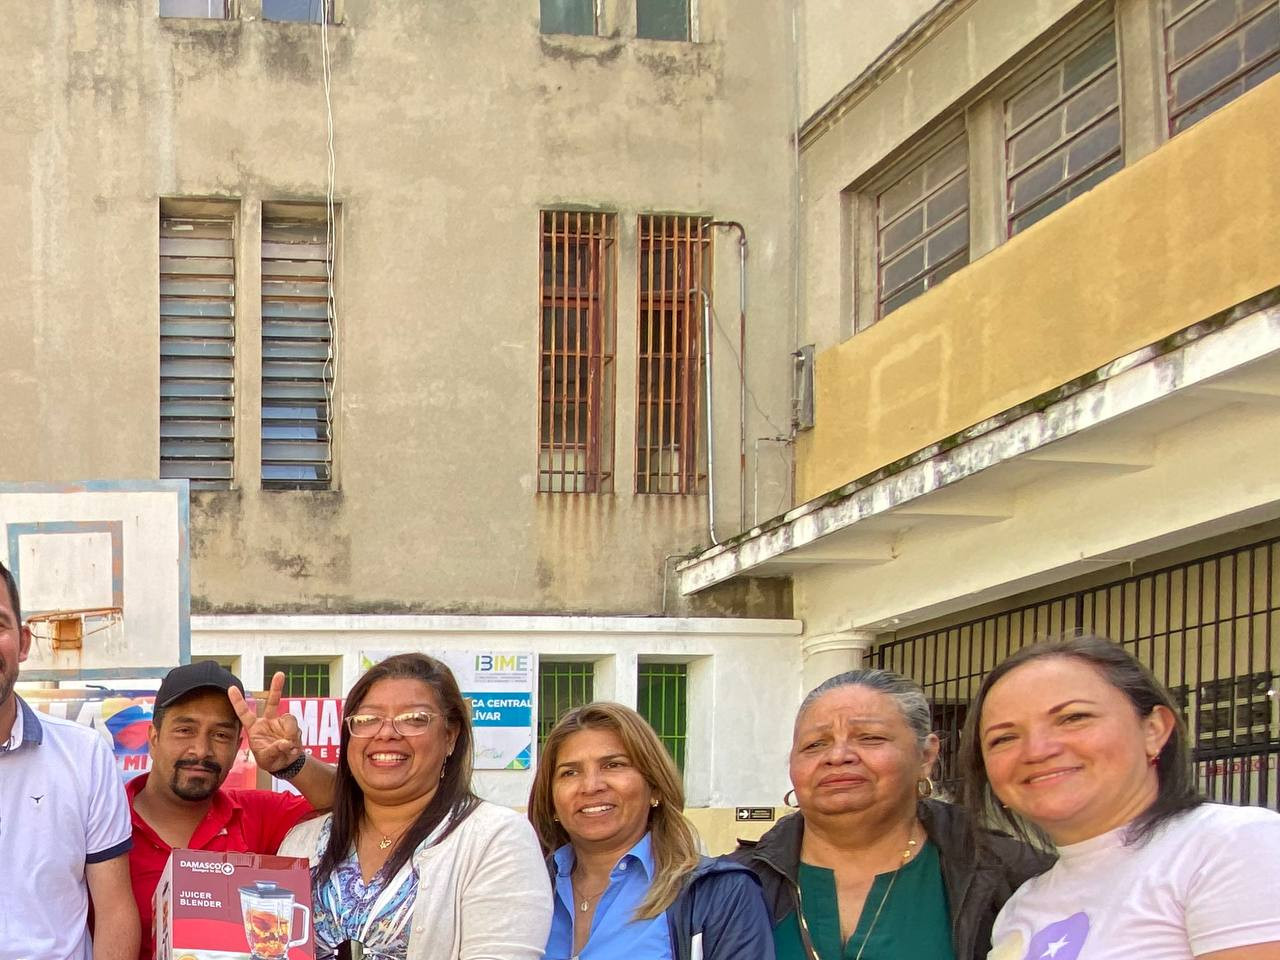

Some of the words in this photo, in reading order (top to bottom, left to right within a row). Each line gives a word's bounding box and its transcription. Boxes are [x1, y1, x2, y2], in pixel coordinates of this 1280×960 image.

[475, 655, 528, 671] IBIME
[486, 699, 533, 708] CENTRAL
[180, 860, 222, 870] DAMASCO
[180, 890, 212, 900] JUICER
[180, 898, 222, 908] BLENDER
